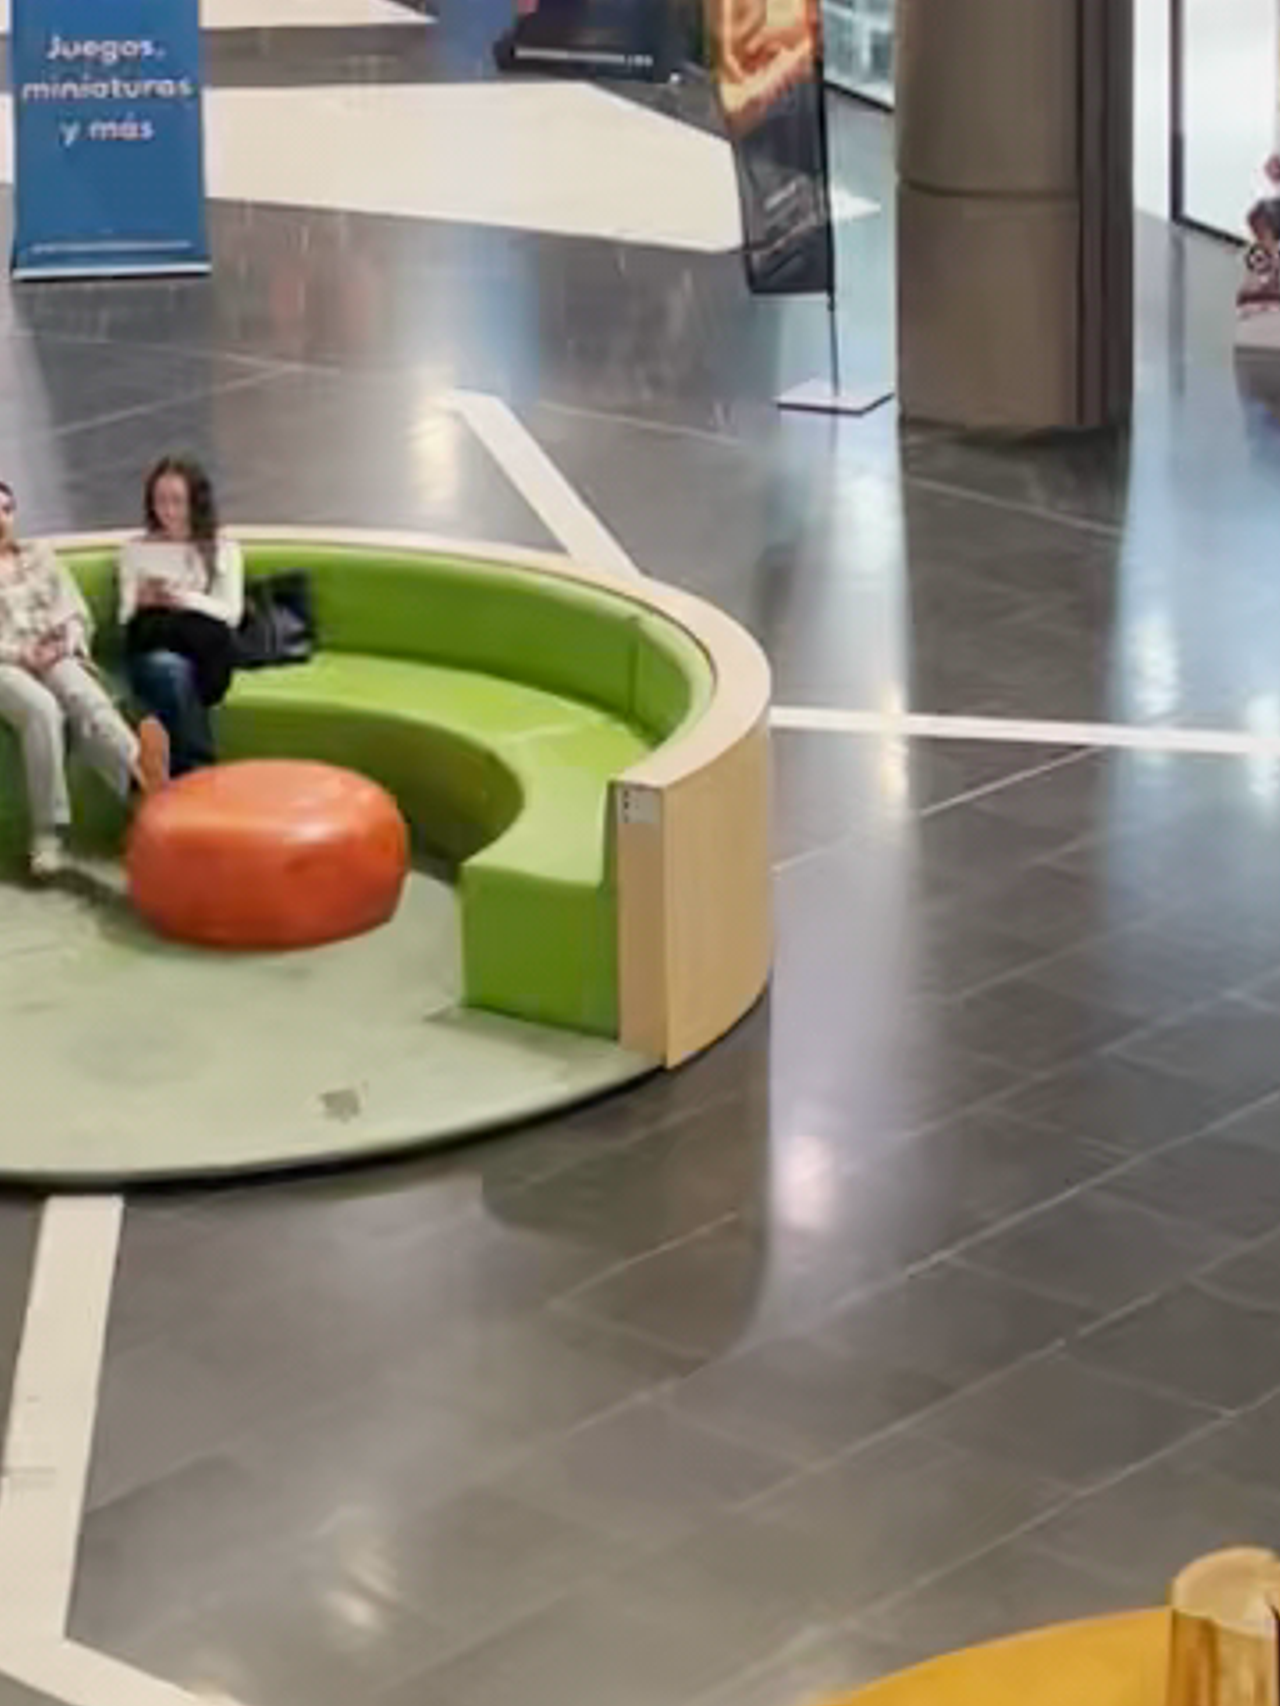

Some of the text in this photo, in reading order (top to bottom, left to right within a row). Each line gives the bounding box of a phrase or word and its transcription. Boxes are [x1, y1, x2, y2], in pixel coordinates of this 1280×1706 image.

[22, 75, 194, 101] miniaturas
[58, 110, 154, 148] y más
